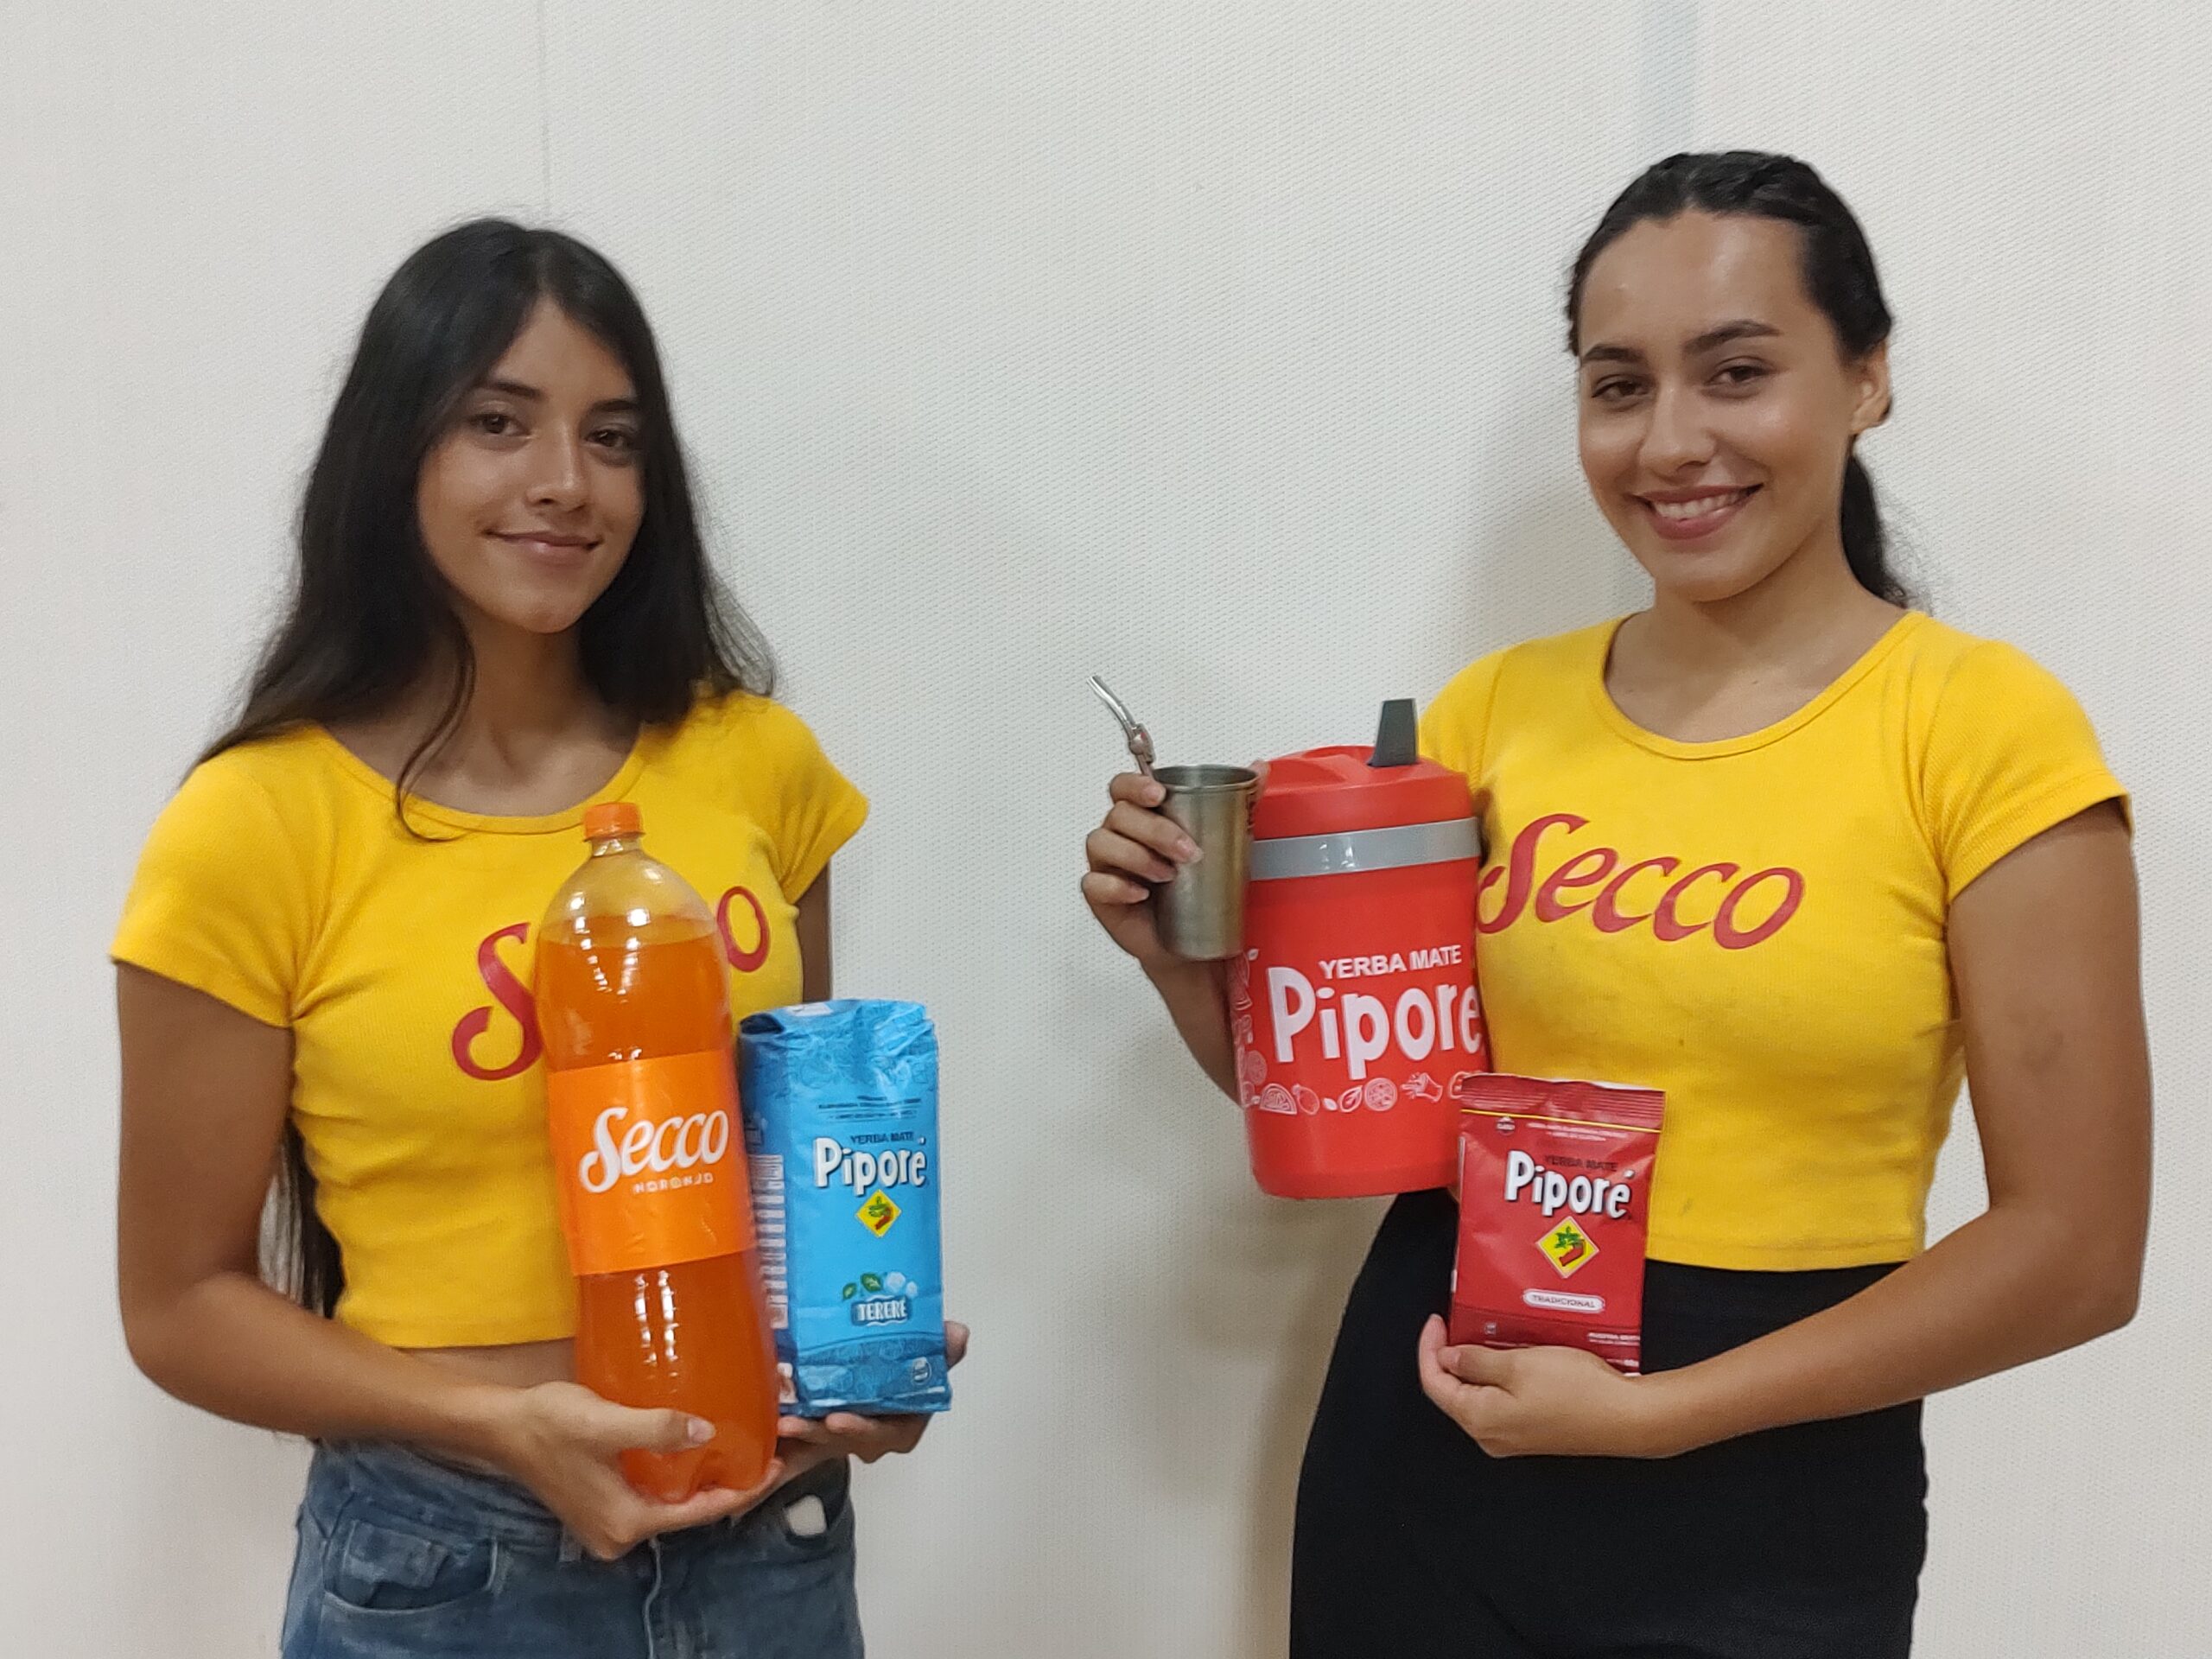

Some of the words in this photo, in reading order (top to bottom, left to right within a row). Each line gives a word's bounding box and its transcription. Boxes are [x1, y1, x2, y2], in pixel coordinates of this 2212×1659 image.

[1477, 812, 1805, 950] Secco
[1319, 953, 1407, 979] YERBA
[1409, 944, 1462, 969] MATE
[578, 1106, 729, 1193] Secco
[815, 1135, 927, 1197] Piporé
[1503, 1149, 1636, 1219] Piporé
[1531, 1294, 1597, 1308] TRADICIONAL
